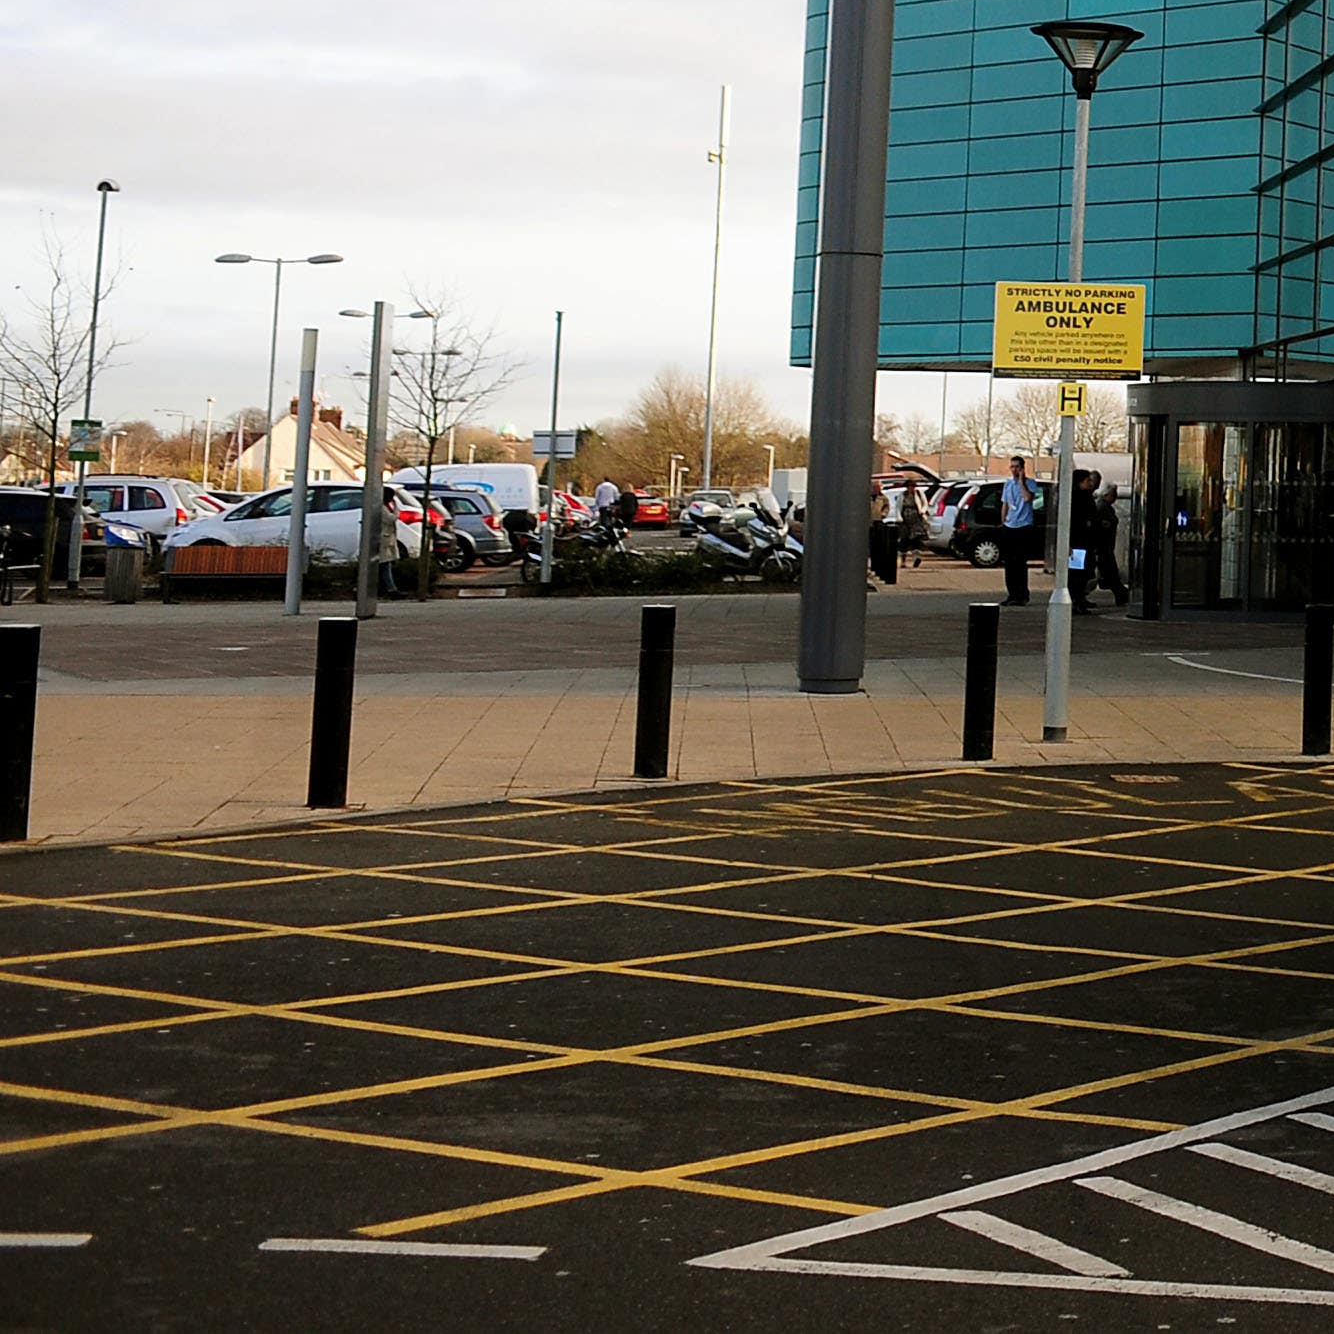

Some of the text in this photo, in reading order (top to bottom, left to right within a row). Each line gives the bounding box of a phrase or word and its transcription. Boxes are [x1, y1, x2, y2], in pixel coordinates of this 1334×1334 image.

[1007, 288, 1135, 298] STRICTLY NO PARKING
[1015, 301, 1127, 314] AMBULANCE
[1046, 316, 1093, 328] ONLY
[1061, 387, 1082, 411] H
